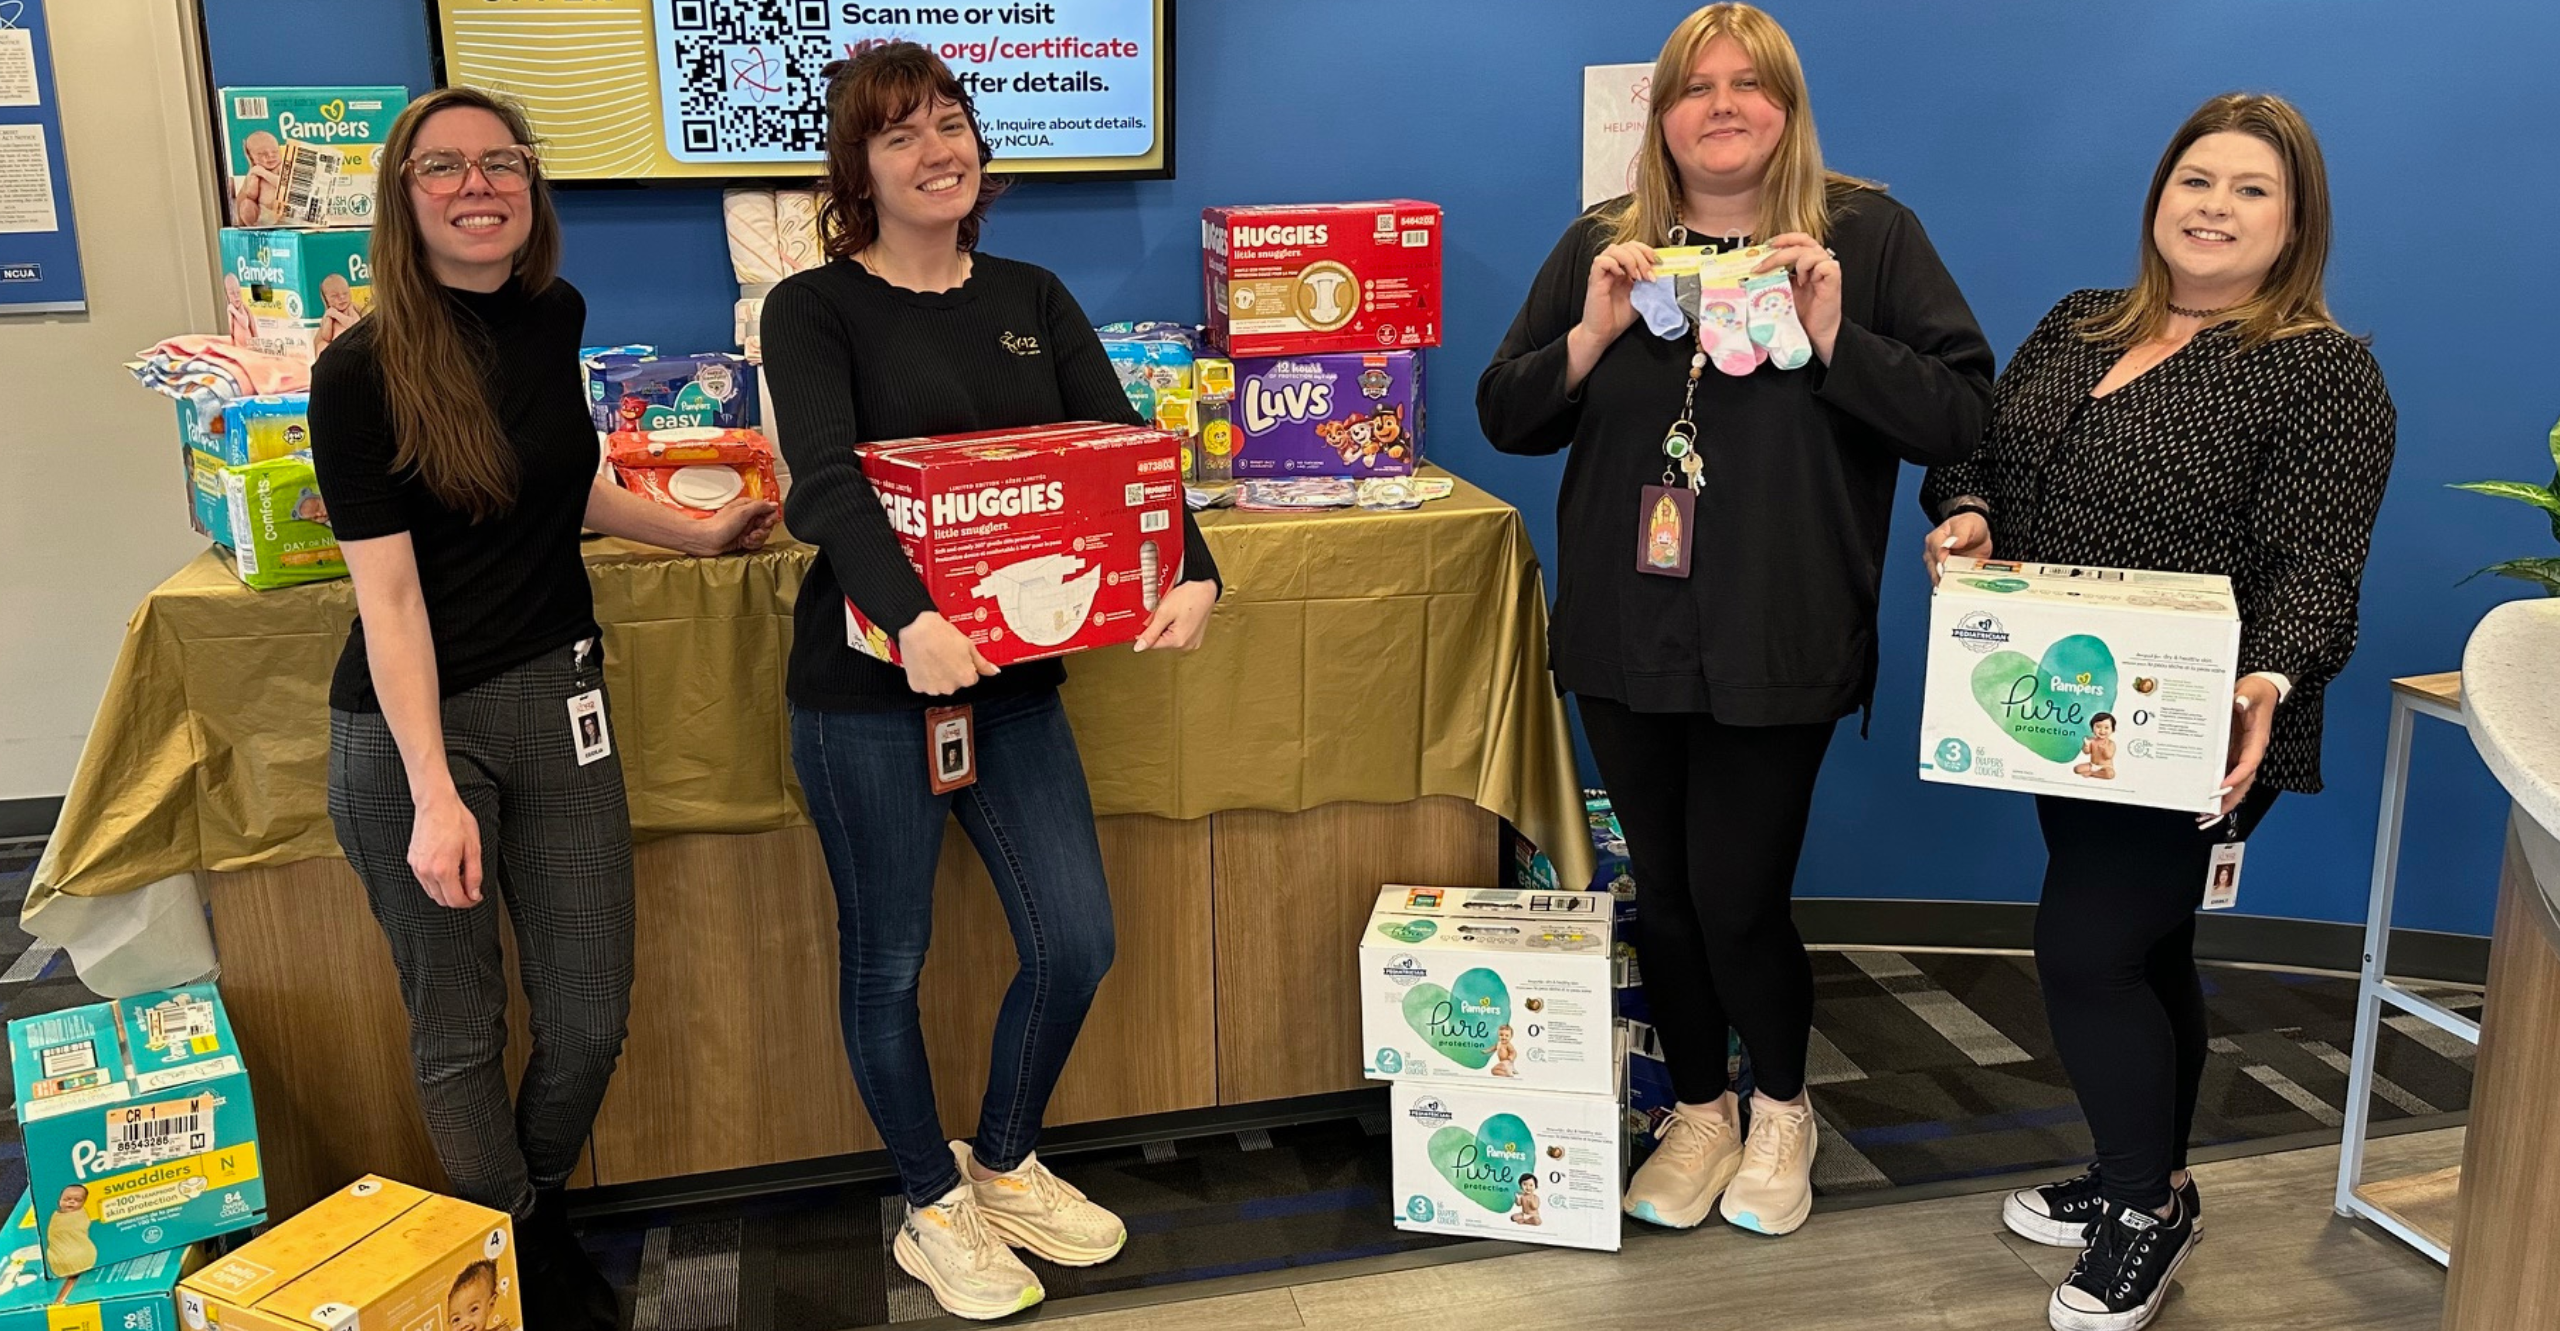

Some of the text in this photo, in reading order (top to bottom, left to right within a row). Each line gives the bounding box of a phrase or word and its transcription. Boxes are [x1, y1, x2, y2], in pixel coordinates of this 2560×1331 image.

[842, 3, 1055, 25] Scan me or visit
[958, 71, 1110, 93] ffer details.
[278, 111, 370, 142] Pampers
[997, 118, 1046, 132] Inquire
[1049, 117, 1092, 130] about
[1094, 117, 1146, 129] details.
[1603, 121, 1645, 133] HELPIN
[984, 135, 1054, 149] by NCUA.
[1232, 225, 1329, 248] HUGGIES
[1234, 250, 1256, 260] little
[4, 268, 36, 279] NCUA
[236, 255, 285, 284] Pampers
[1426, 322, 1433, 336] 1
[1292, 361, 1323, 374] hours
[681, 402, 711, 412] Pampers
[932, 481, 1064, 527] HUGGIES
[934, 526, 959, 540] little
[284, 540, 305, 552] DAY
[2050, 677, 2104, 697] Pampers
[2000, 674, 2084, 725] Pure
[2014, 723, 2076, 738] protection
[1945, 741, 1962, 761] 3
[1975, 756, 2003, 768] DIAPERS
[1974, 766, 2005, 778] COUCHES
[1461, 1001, 1501, 1016] Pampers
[1426, 1001, 1489, 1039] Pure
[1438, 1040, 1485, 1049] protection
[1383, 1050, 1394, 1065] 2
[126, 1099, 200, 1124] CR 1 M
[193, 1135, 203, 1147] M
[1486, 1144, 1526, 1161] Pampers
[221, 1155, 235, 1171] N
[1451, 1144, 1514, 1183] Pure
[104, 1165, 191, 1195] swaddlers
[1463, 1182, 1510, 1193] protection
[224, 1191, 242, 1204] 84
[105, 1194, 179, 1218] skin protection
[1414, 1197, 1427, 1214] 3
[490, 1230, 500, 1246] 4
[186, 1300, 199, 1314] 74
[123, 1312, 137, 1329] 96
